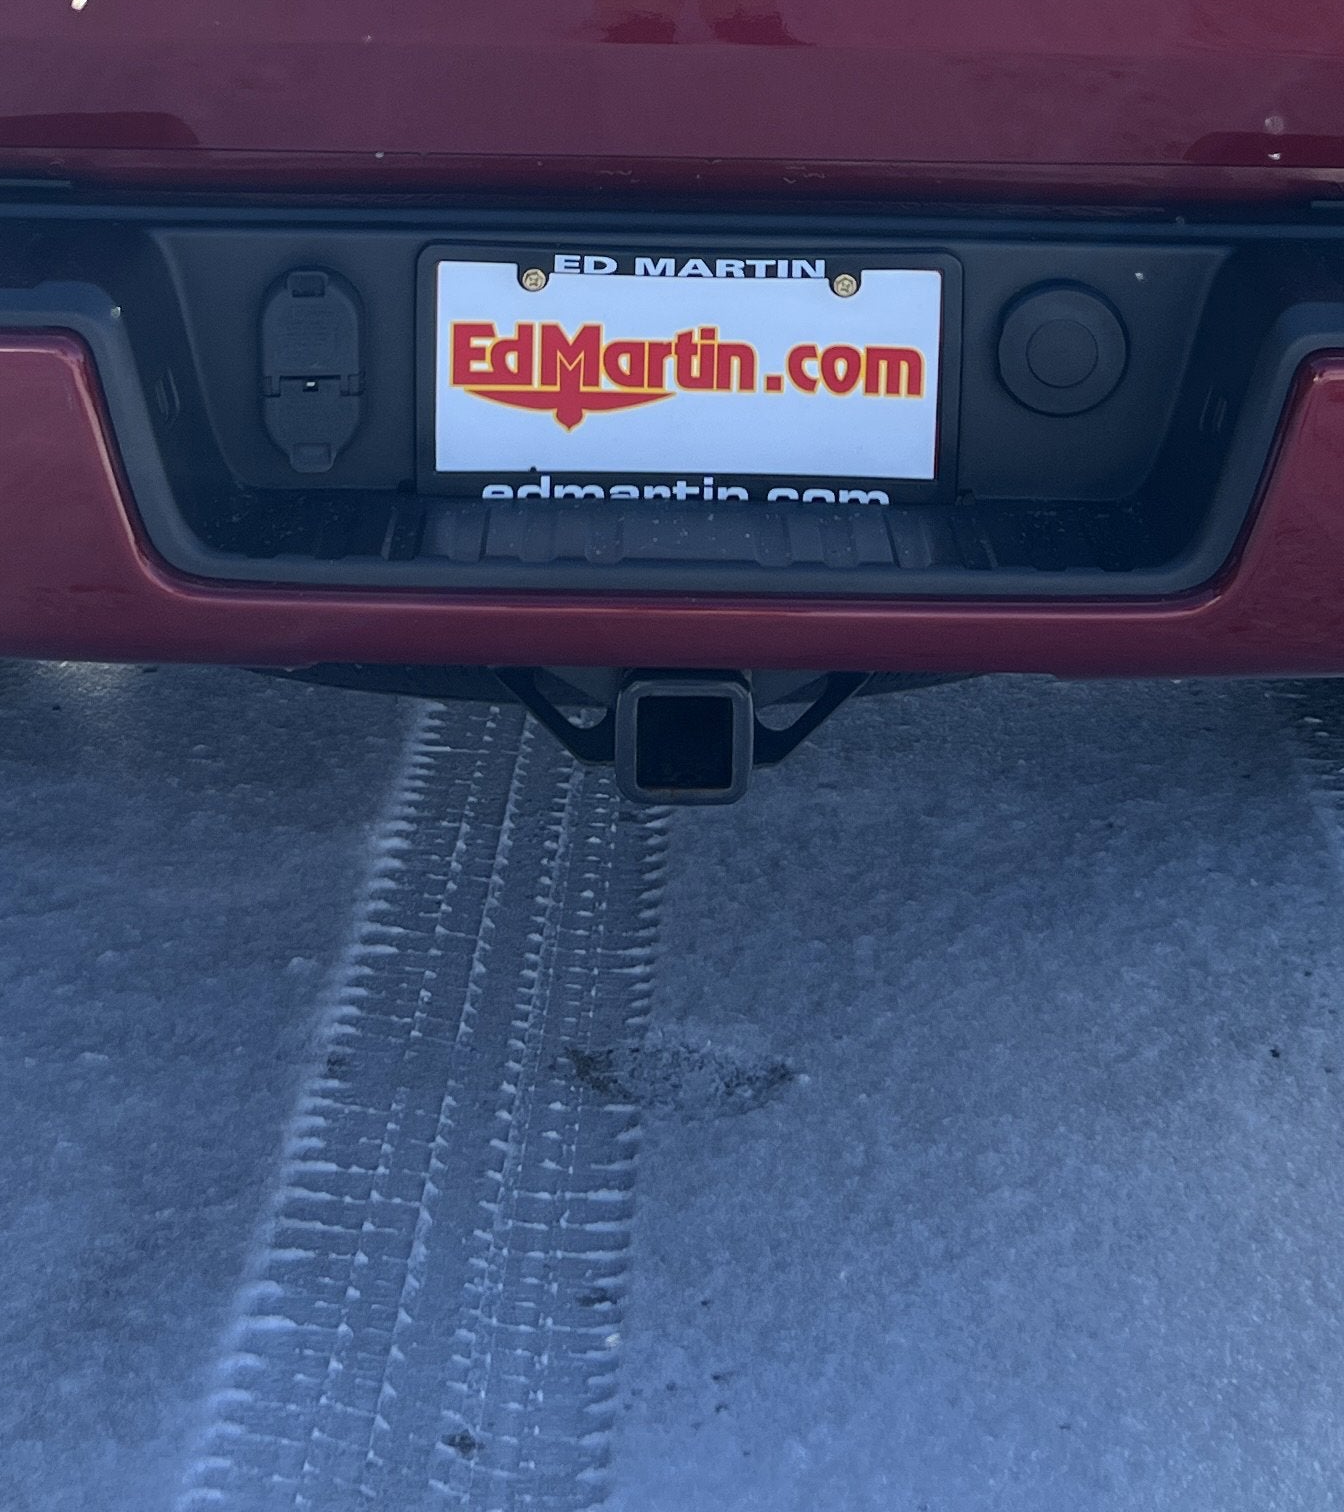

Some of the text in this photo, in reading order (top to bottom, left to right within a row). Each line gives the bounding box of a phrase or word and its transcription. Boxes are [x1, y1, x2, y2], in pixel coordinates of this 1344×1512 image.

[553, 254, 826, 279] ED MARTIN
[450, 320, 925, 432] EdMartin.com
[482, 475, 890, 505] edmartincom
